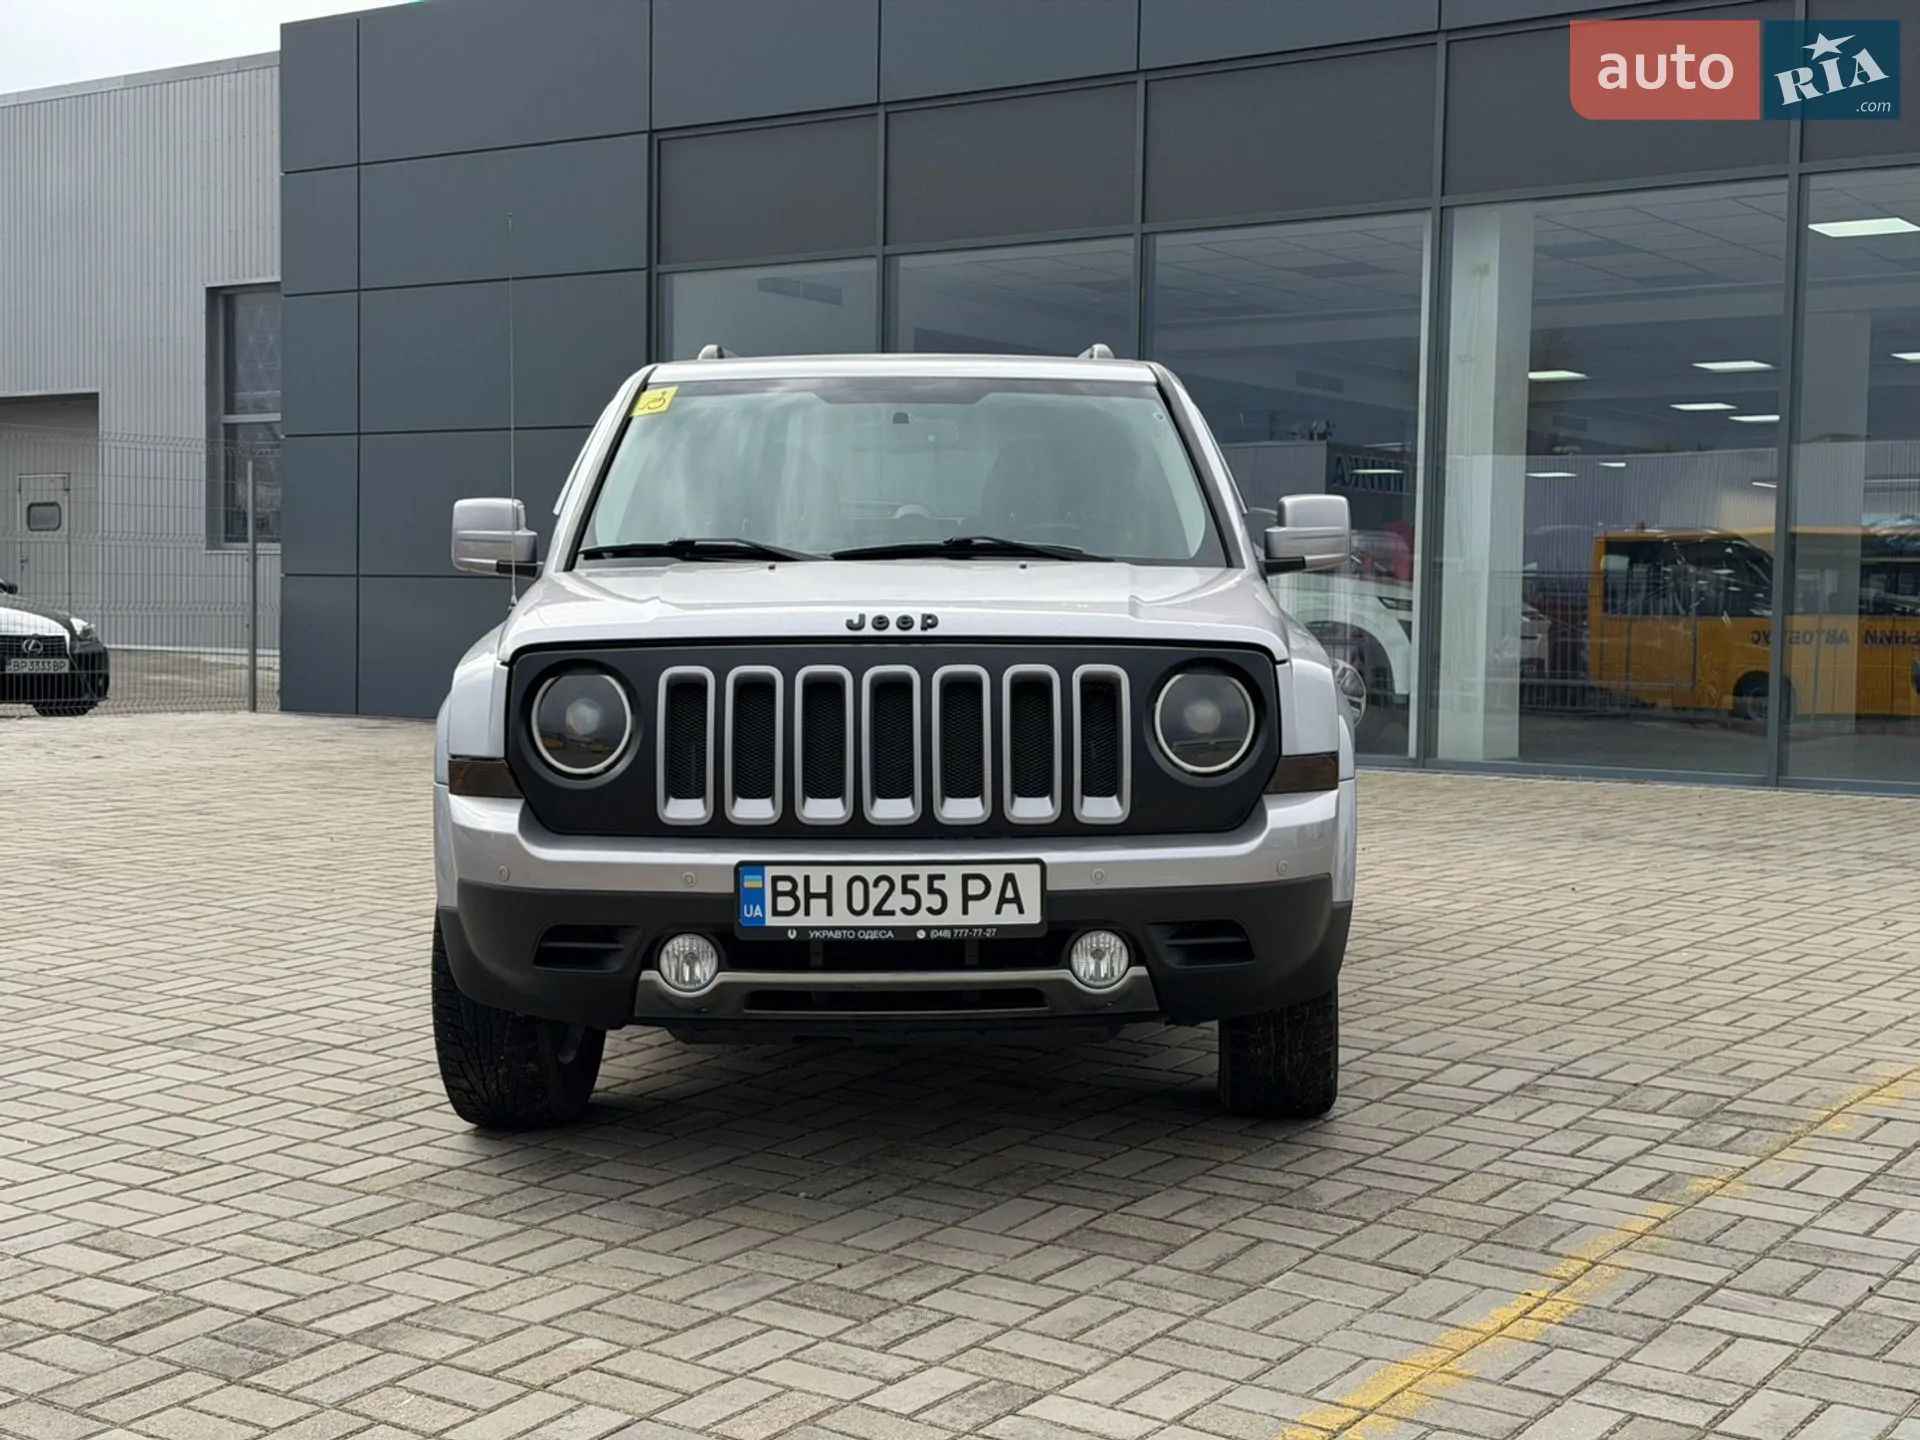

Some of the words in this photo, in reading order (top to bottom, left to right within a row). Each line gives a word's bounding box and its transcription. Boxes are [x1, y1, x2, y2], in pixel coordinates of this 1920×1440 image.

[845, 613, 939, 632] Jeep
[771, 874, 834, 917] BH
[846, 873, 948, 916] 0255
[961, 872, 1025, 915] PA
[743, 904, 763, 918] UA
[808, 929, 856, 939] УКРАВТО
[858, 928, 894, 940] ОДЕСА
[929, 928, 951, 939] (048)
[953, 927, 997, 938] 777-77-27
